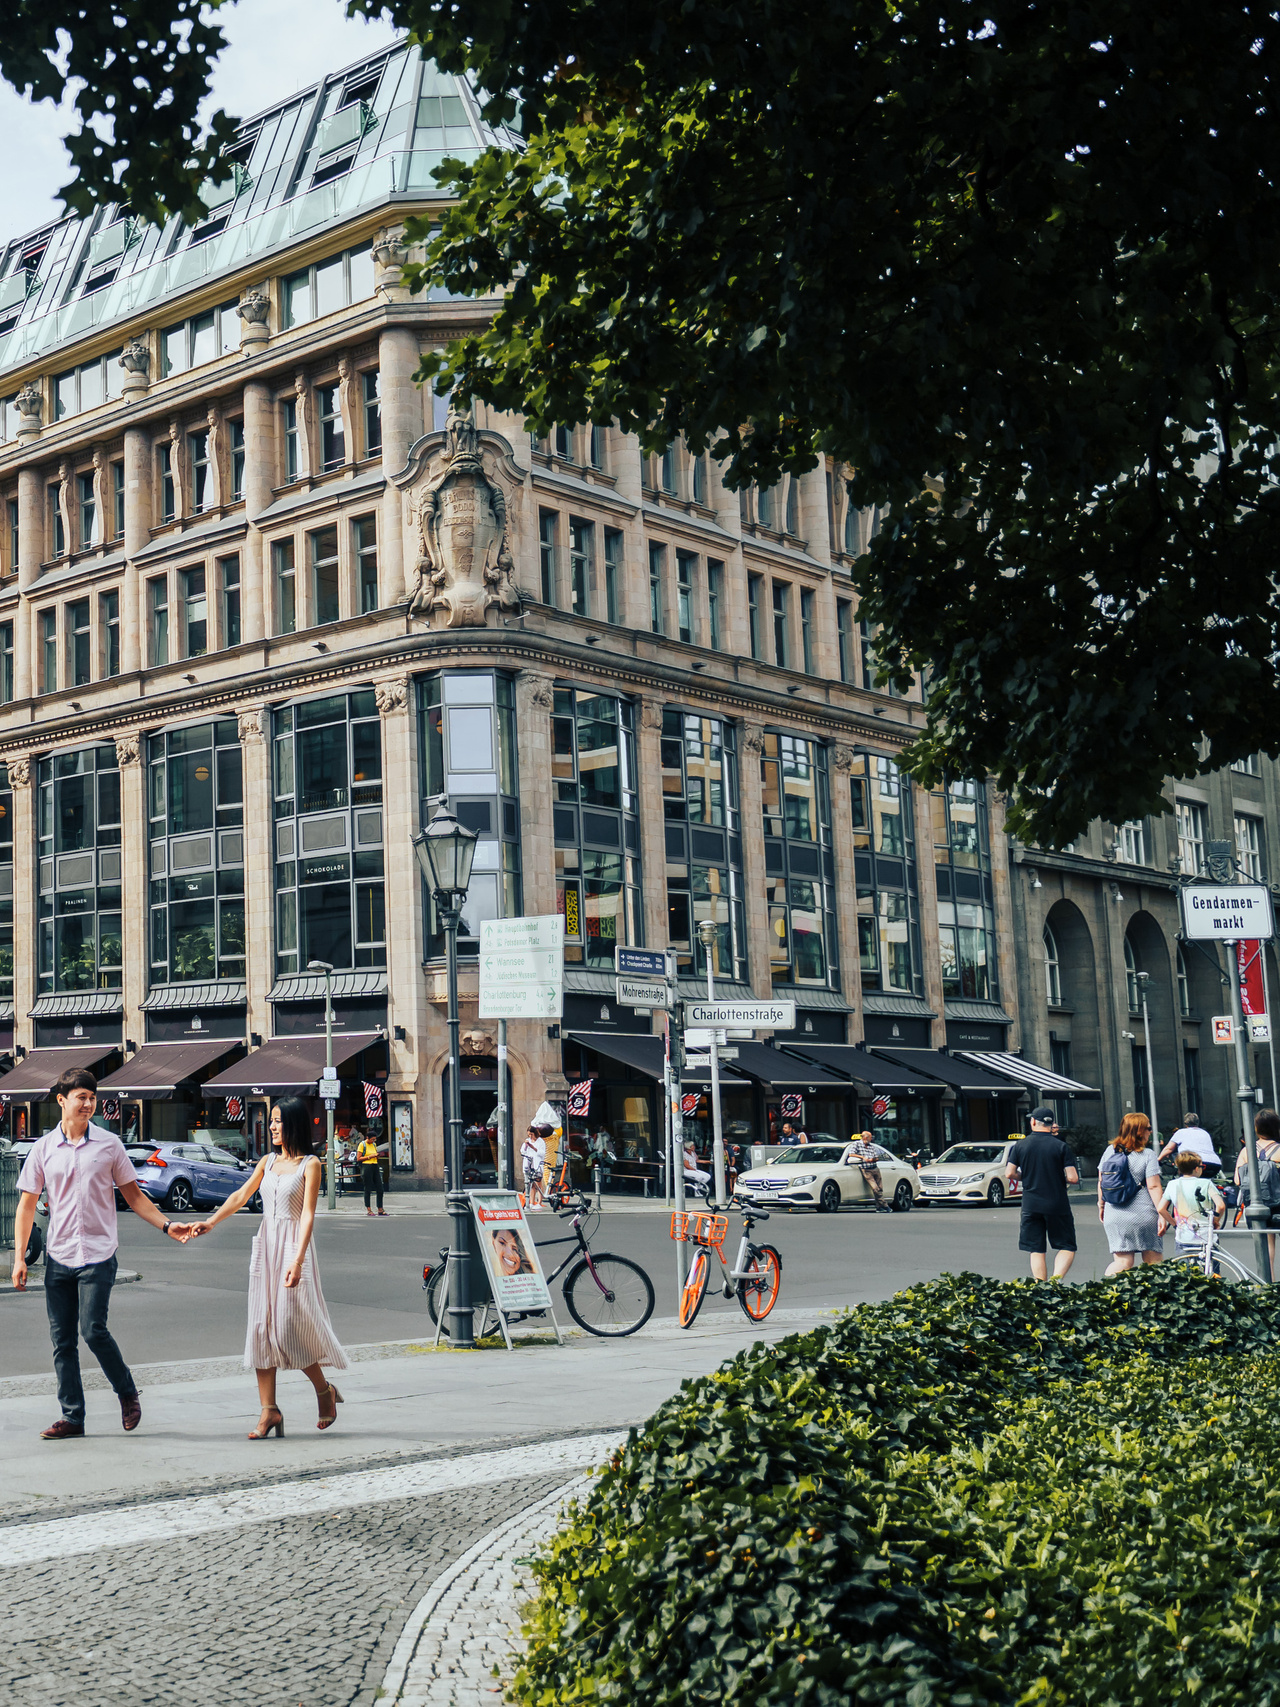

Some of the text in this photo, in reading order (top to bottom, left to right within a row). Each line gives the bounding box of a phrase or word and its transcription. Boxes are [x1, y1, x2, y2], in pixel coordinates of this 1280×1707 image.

[306, 863, 345, 875] SCHOKOLADE
[1192, 895, 1260, 909] Gendarmen-
[1212, 914, 1244, 929] markt
[504, 922, 539, 935] Hauptbahnhof
[528, 936, 540, 945] Platz
[497, 954, 554, 966] Wannsee 21
[518, 971, 537, 979] Museum
[483, 989, 527, 1001] Charlottenburg
[622, 984, 664, 1003] Mohrenstraße
[692, 1007, 784, 1023] Charlottenstraße
